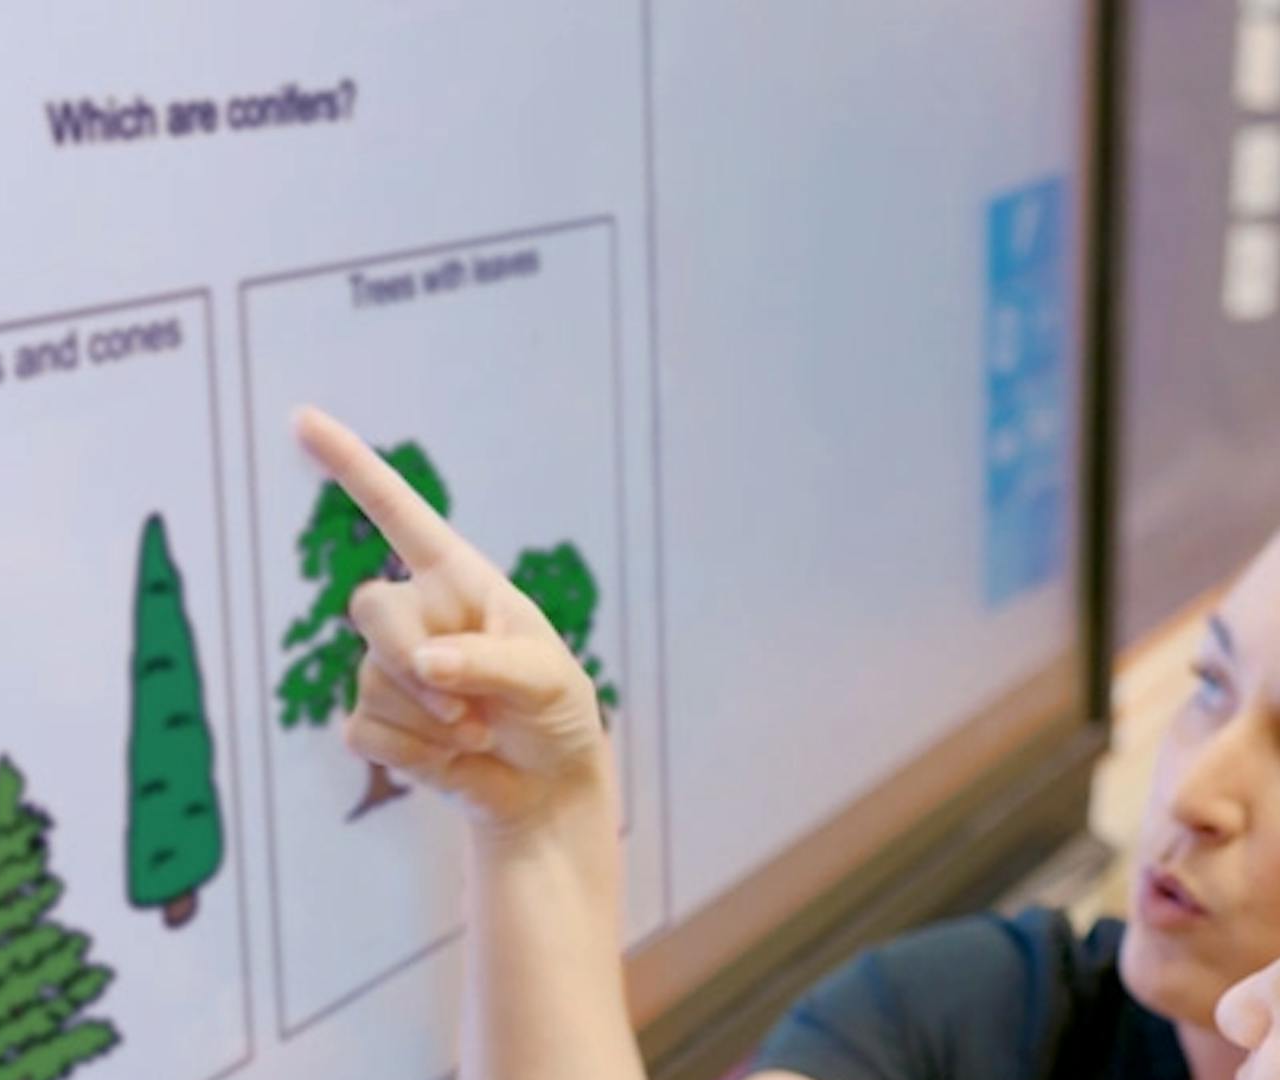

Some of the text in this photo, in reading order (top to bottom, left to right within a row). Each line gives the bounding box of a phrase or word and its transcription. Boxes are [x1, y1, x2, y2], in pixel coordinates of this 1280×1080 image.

[45, 78, 358, 147] Which are conifers?
[348, 272, 418, 309] Trees
[12, 328, 79, 380] and
[86, 315, 184, 365] cones
